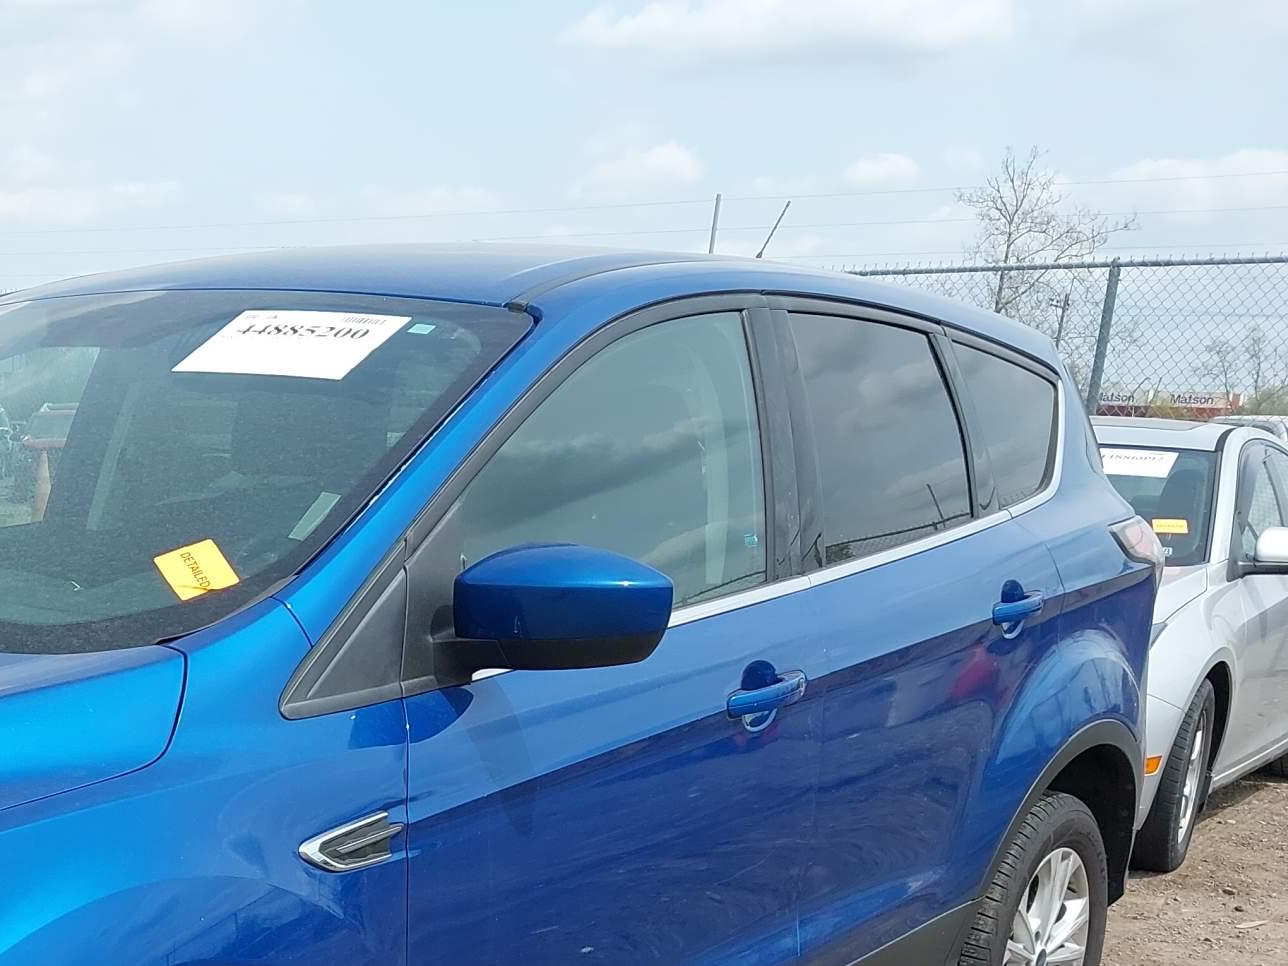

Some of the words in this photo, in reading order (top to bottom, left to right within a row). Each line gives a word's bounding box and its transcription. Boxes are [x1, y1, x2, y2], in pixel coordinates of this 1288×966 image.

[236, 322, 370, 340] 44885200
[1170, 393, 1215, 405] Matson
[180, 551, 212, 588] DETAILED
